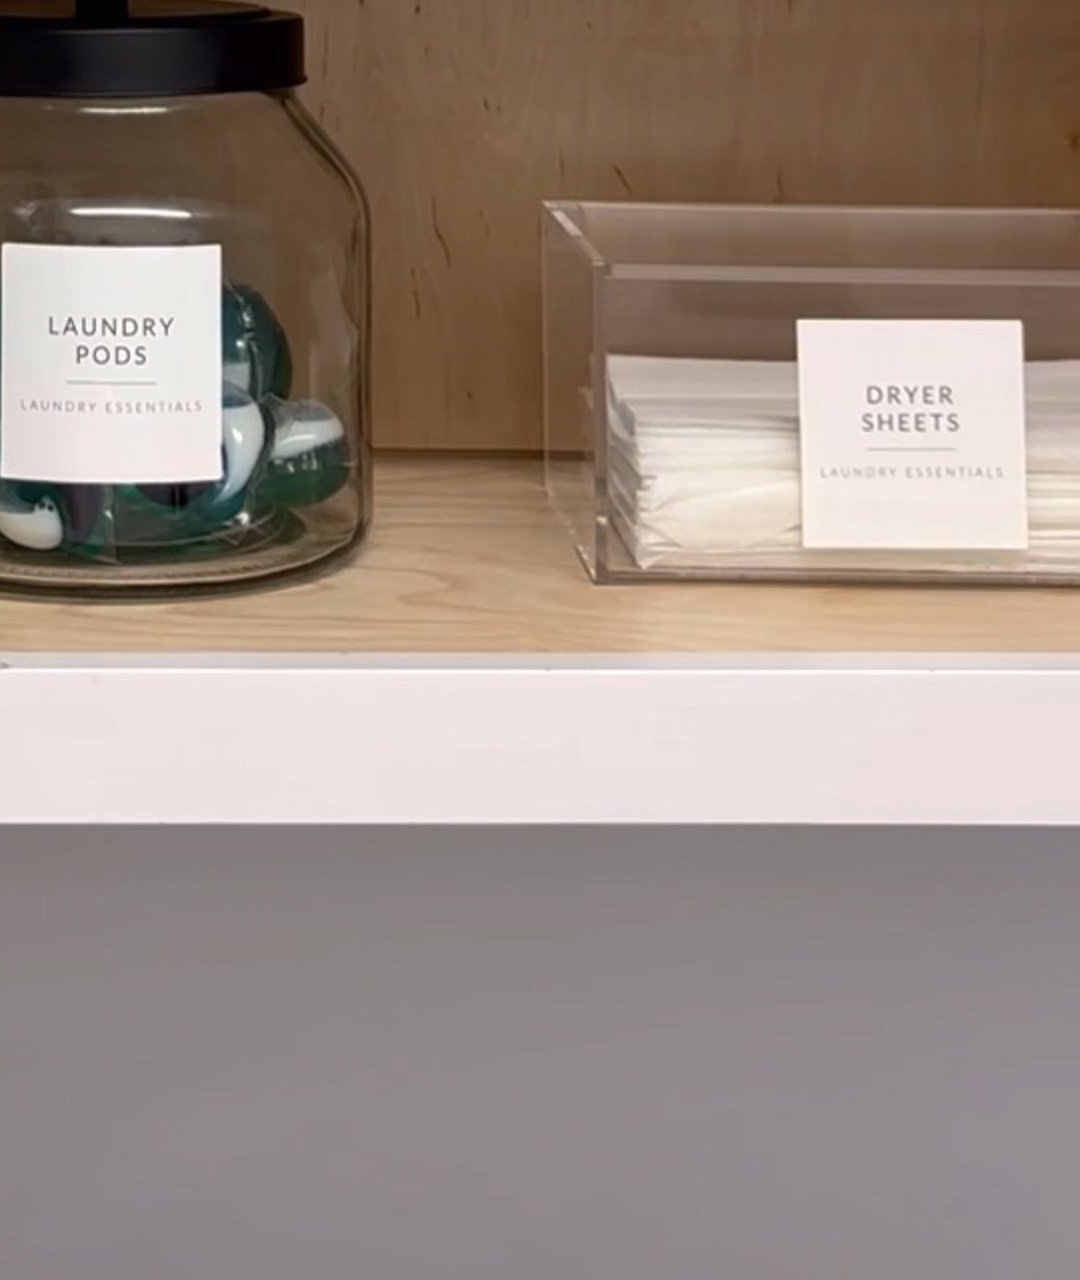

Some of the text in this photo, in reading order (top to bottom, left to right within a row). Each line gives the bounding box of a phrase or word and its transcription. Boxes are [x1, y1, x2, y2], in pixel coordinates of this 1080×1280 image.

[48, 316, 176, 337] LAUNDRY
[75, 345, 148, 366] PODS
[865, 385, 954, 406] DRYER
[20, 398, 203, 415] LAUNDRY ESSENTIALS
[860, 412, 961, 433] SHEETS
[819, 466, 1005, 480] LAUNDRY ESSENTIALS
